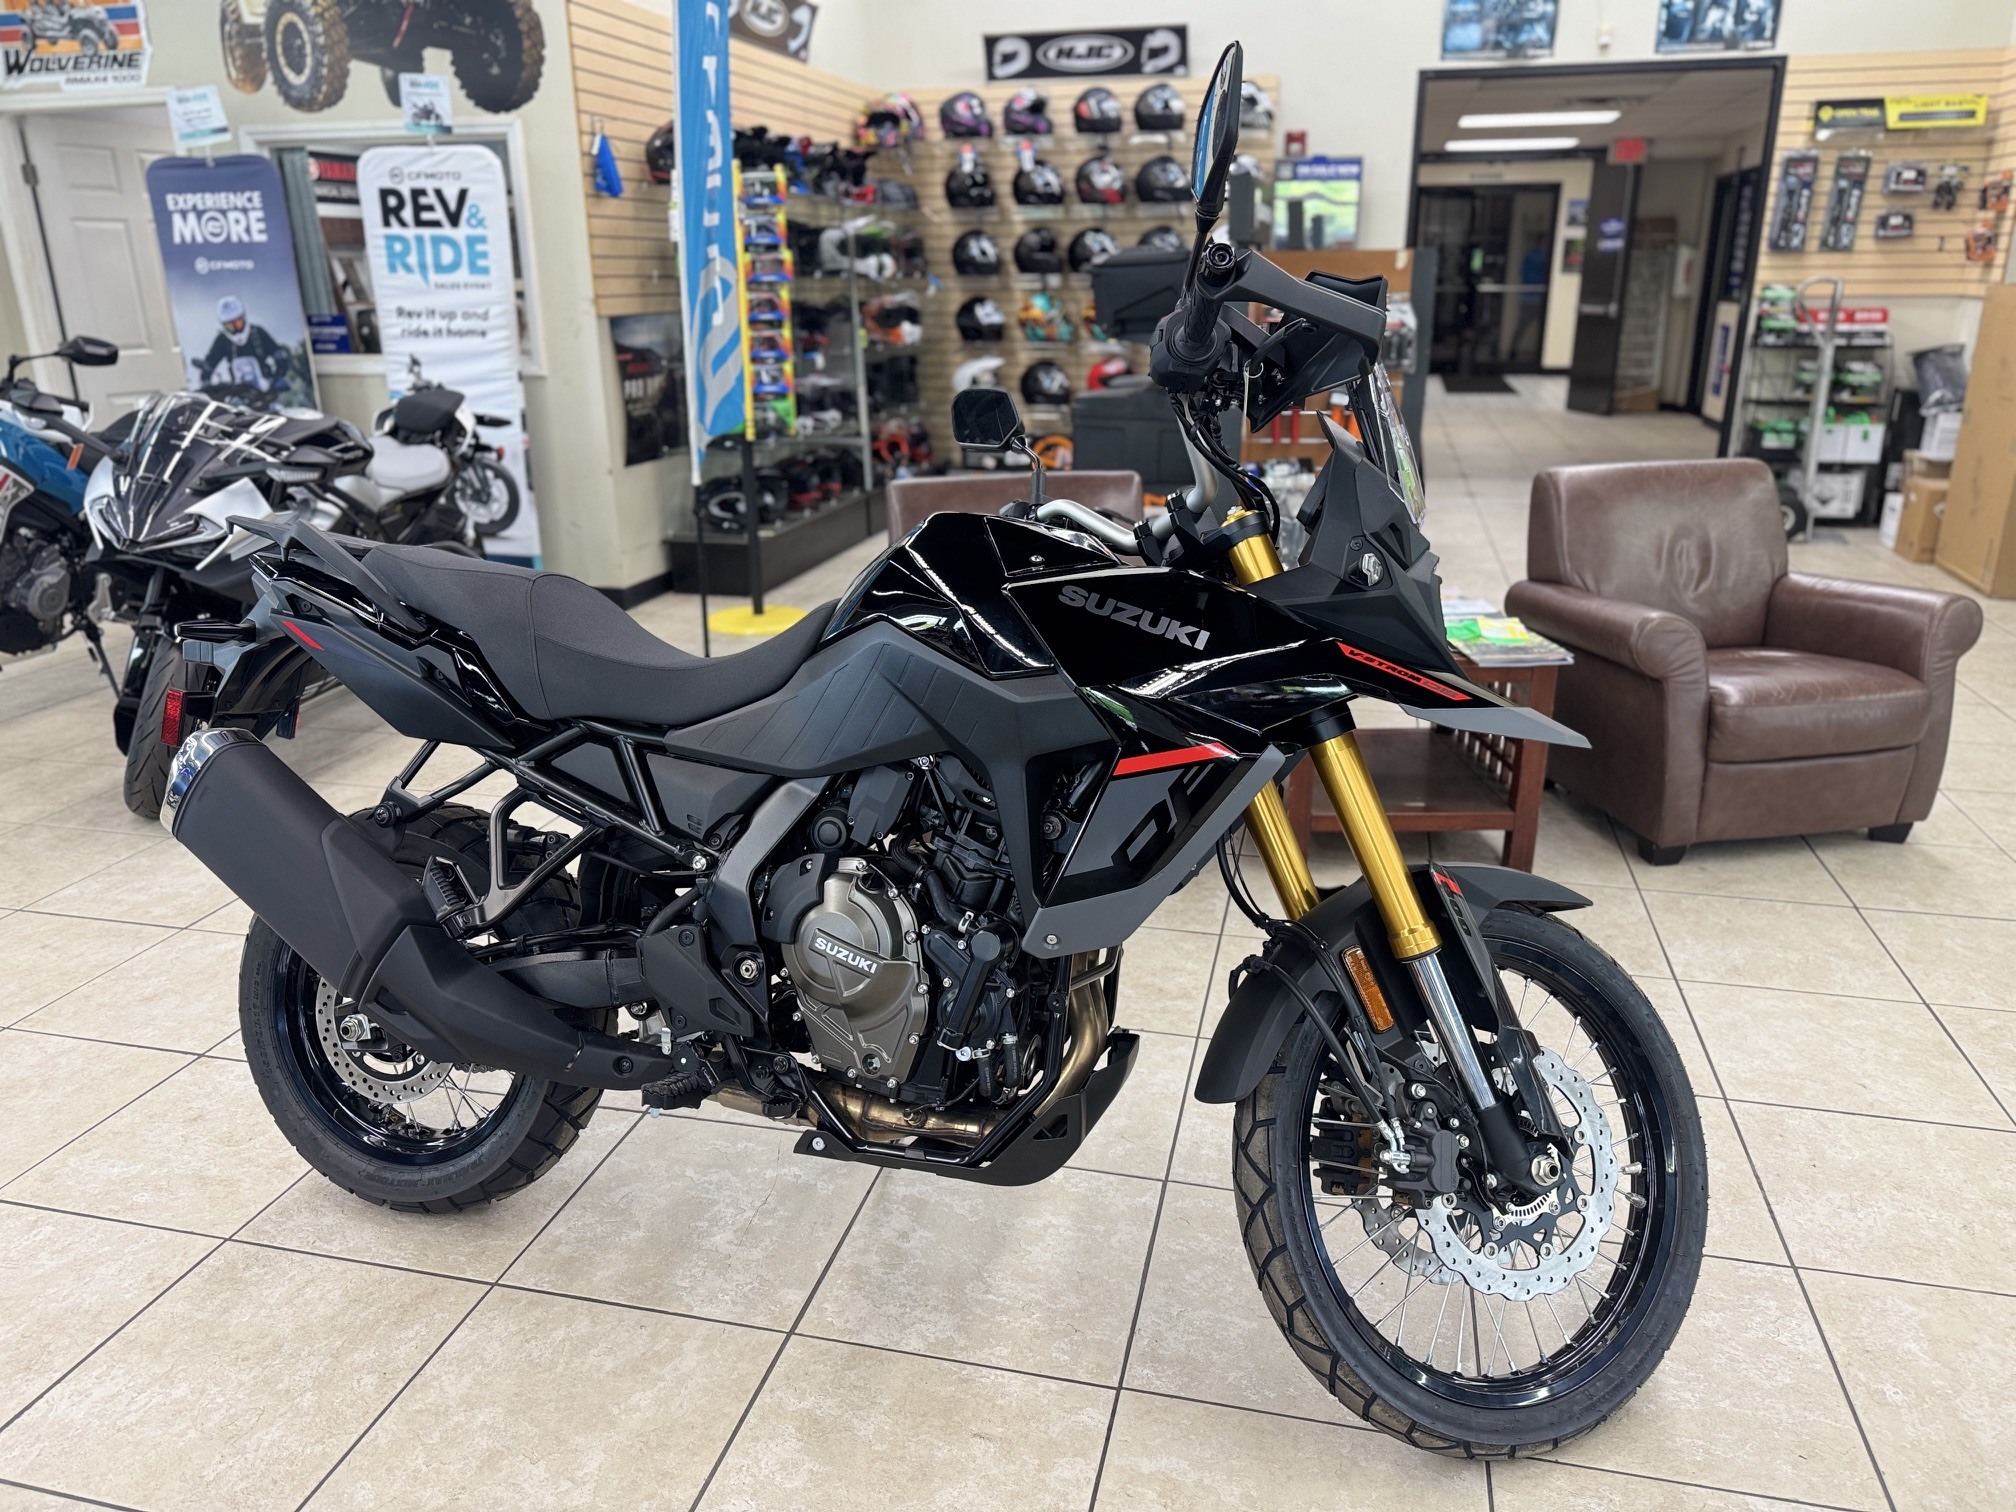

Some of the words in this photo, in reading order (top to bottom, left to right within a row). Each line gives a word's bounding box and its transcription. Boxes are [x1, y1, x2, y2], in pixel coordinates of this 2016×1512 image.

[4, 49, 141, 76] WOLVERINE
[407, 170, 462, 181] CFMOTO
[165, 190, 263, 212] EXPERIENCE
[378, 187, 469, 229] REV
[466, 203, 487, 230] &
[171, 209, 269, 245] MORE
[383, 234, 491, 286] RIDE
[1058, 584, 1210, 651] SUZUKI
[1348, 649, 1422, 683] V-STROM
[814, 937, 878, 974] SUZUKI
